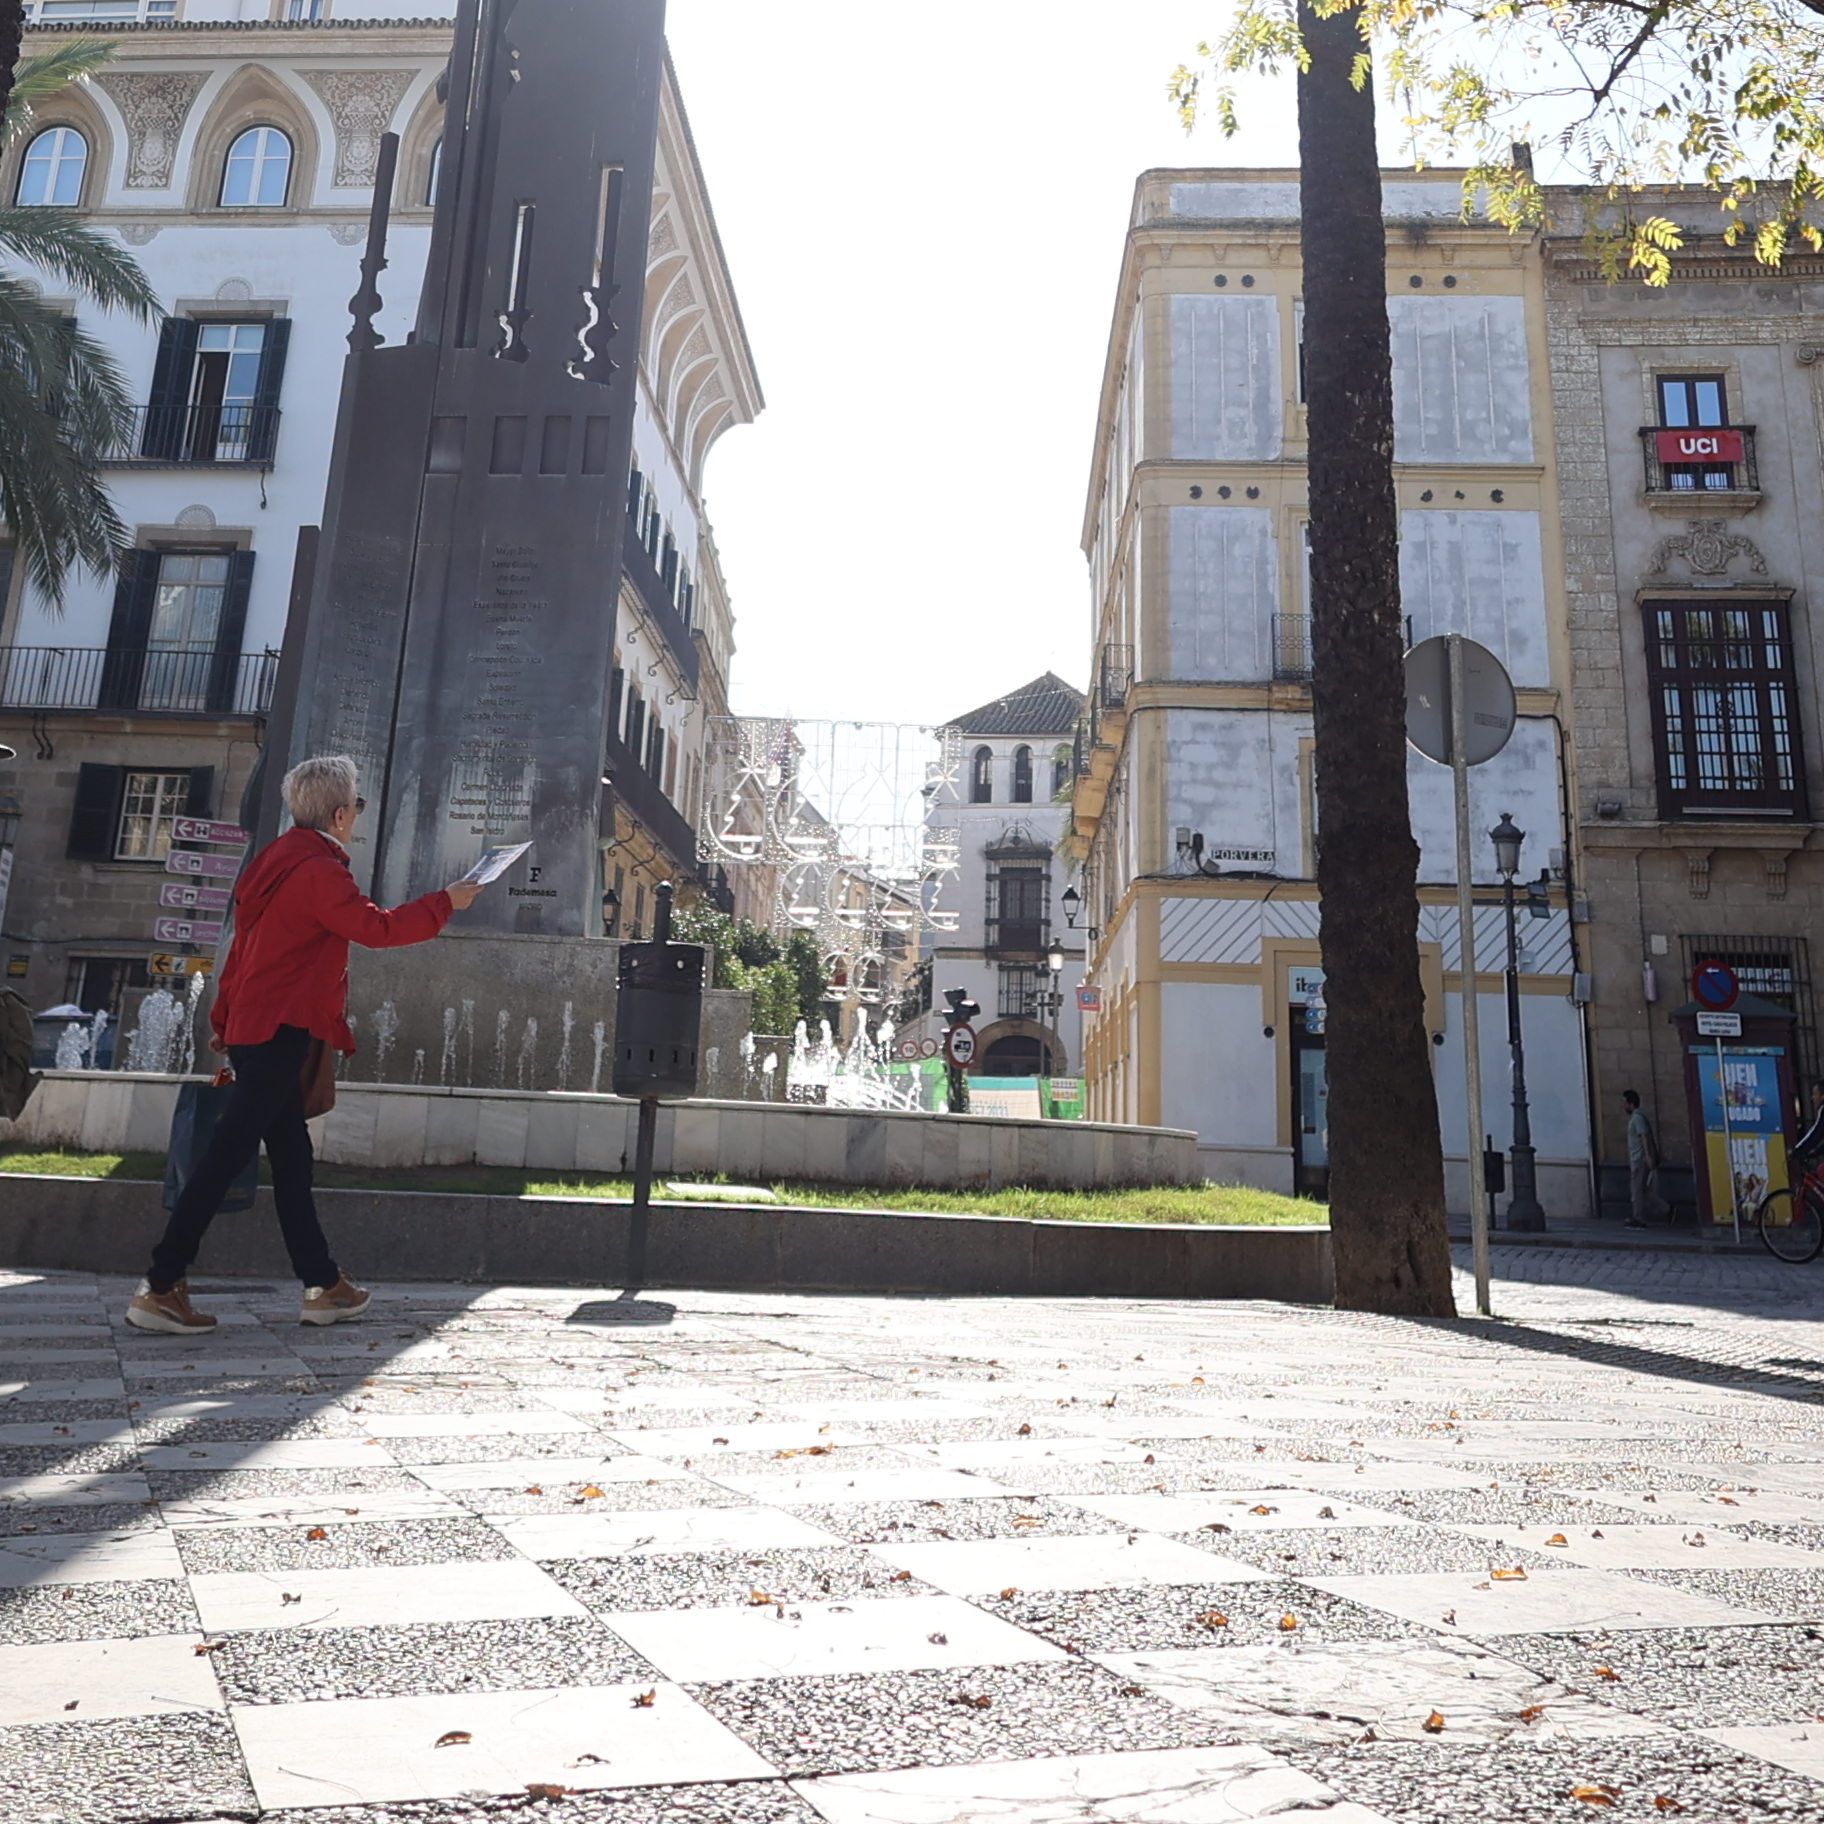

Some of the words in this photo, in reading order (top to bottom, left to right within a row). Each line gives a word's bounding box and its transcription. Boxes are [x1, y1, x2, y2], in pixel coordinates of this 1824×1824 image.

[1679, 438, 1719, 455] UCI
[1213, 849, 1274, 862] PORVERA
[529, 867, 542, 883] F
[508, 886, 557, 898] Fademesa
